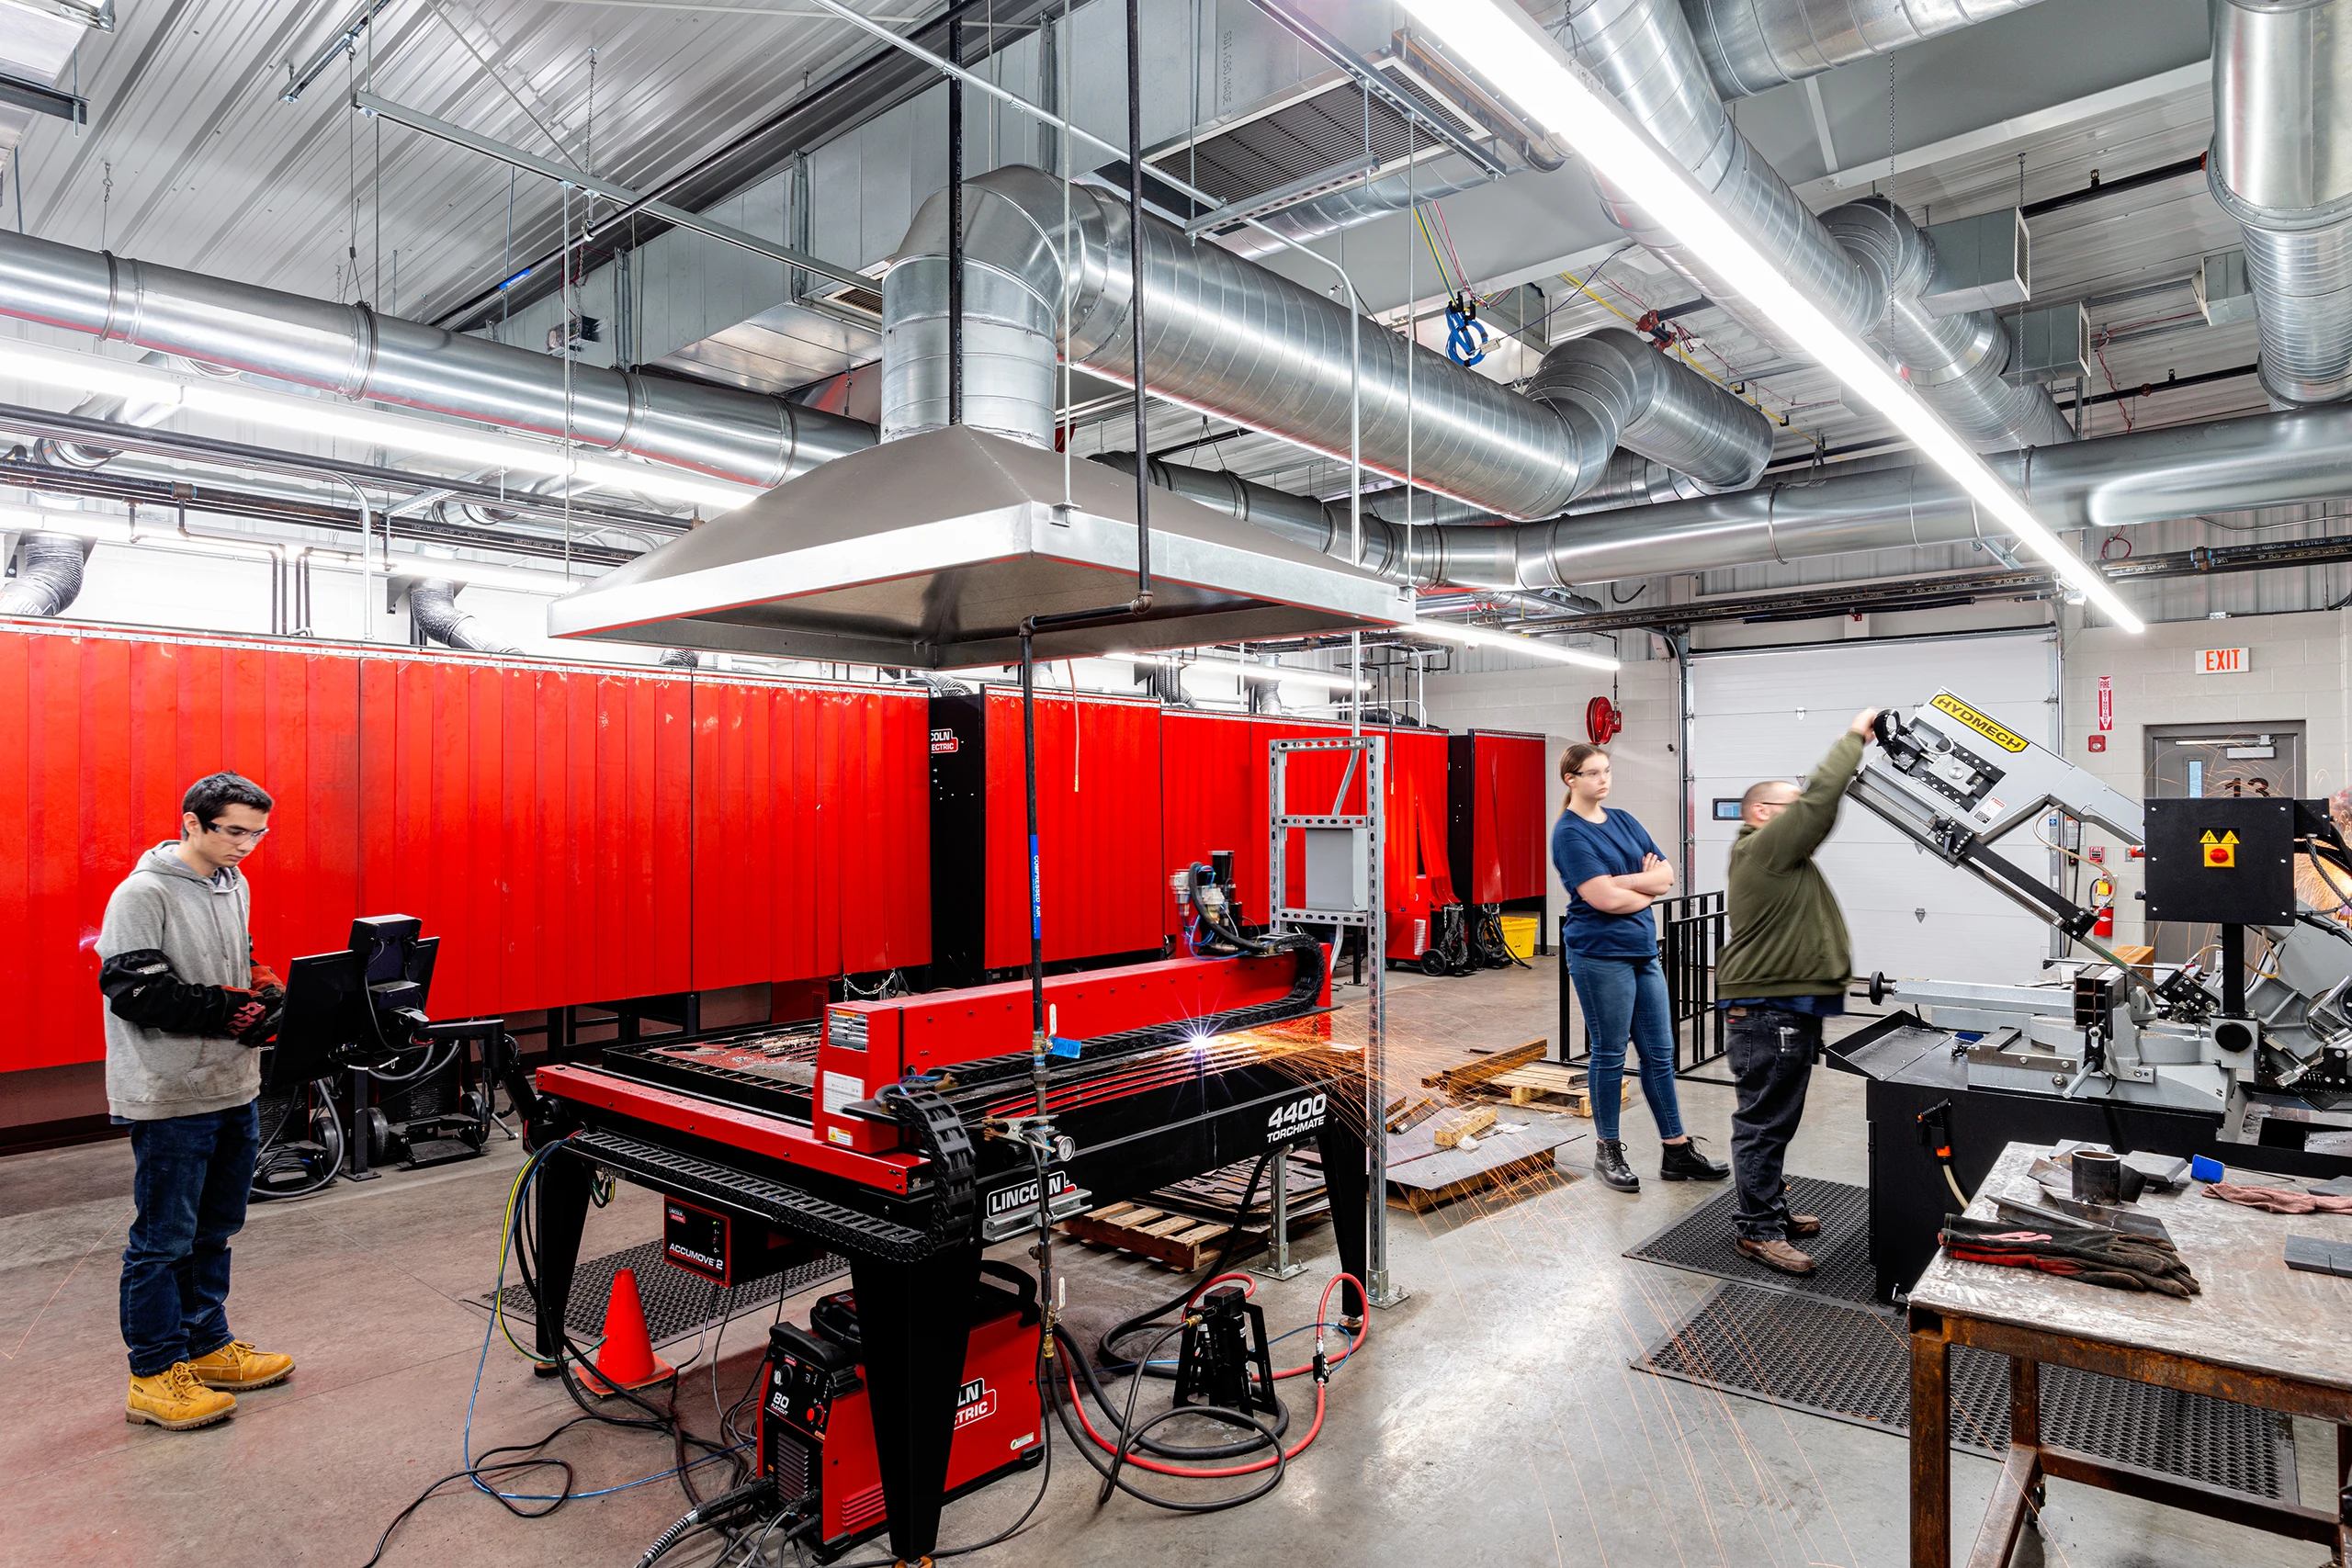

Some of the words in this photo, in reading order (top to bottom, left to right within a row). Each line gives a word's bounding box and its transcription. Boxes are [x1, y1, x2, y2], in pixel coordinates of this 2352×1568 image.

[2206, 649, 2240, 671] EXIT
[2099, 681, 2110, 689] FIRE
[1937, 698, 2022, 749] HYDMECH
[931, 742, 955, 751] ECTRIC
[1268, 1093, 1327, 1128] 4400
[1267, 1116, 1325, 1143] TORCHMATE
[992, 1176, 1061, 1213] LINCON
[669, 1243, 715, 1267] ACCUMOVE
[716, 1259, 724, 1270] 2
[773, 1392, 790, 1409] 80
[957, 1401, 988, 1423] TRIC
